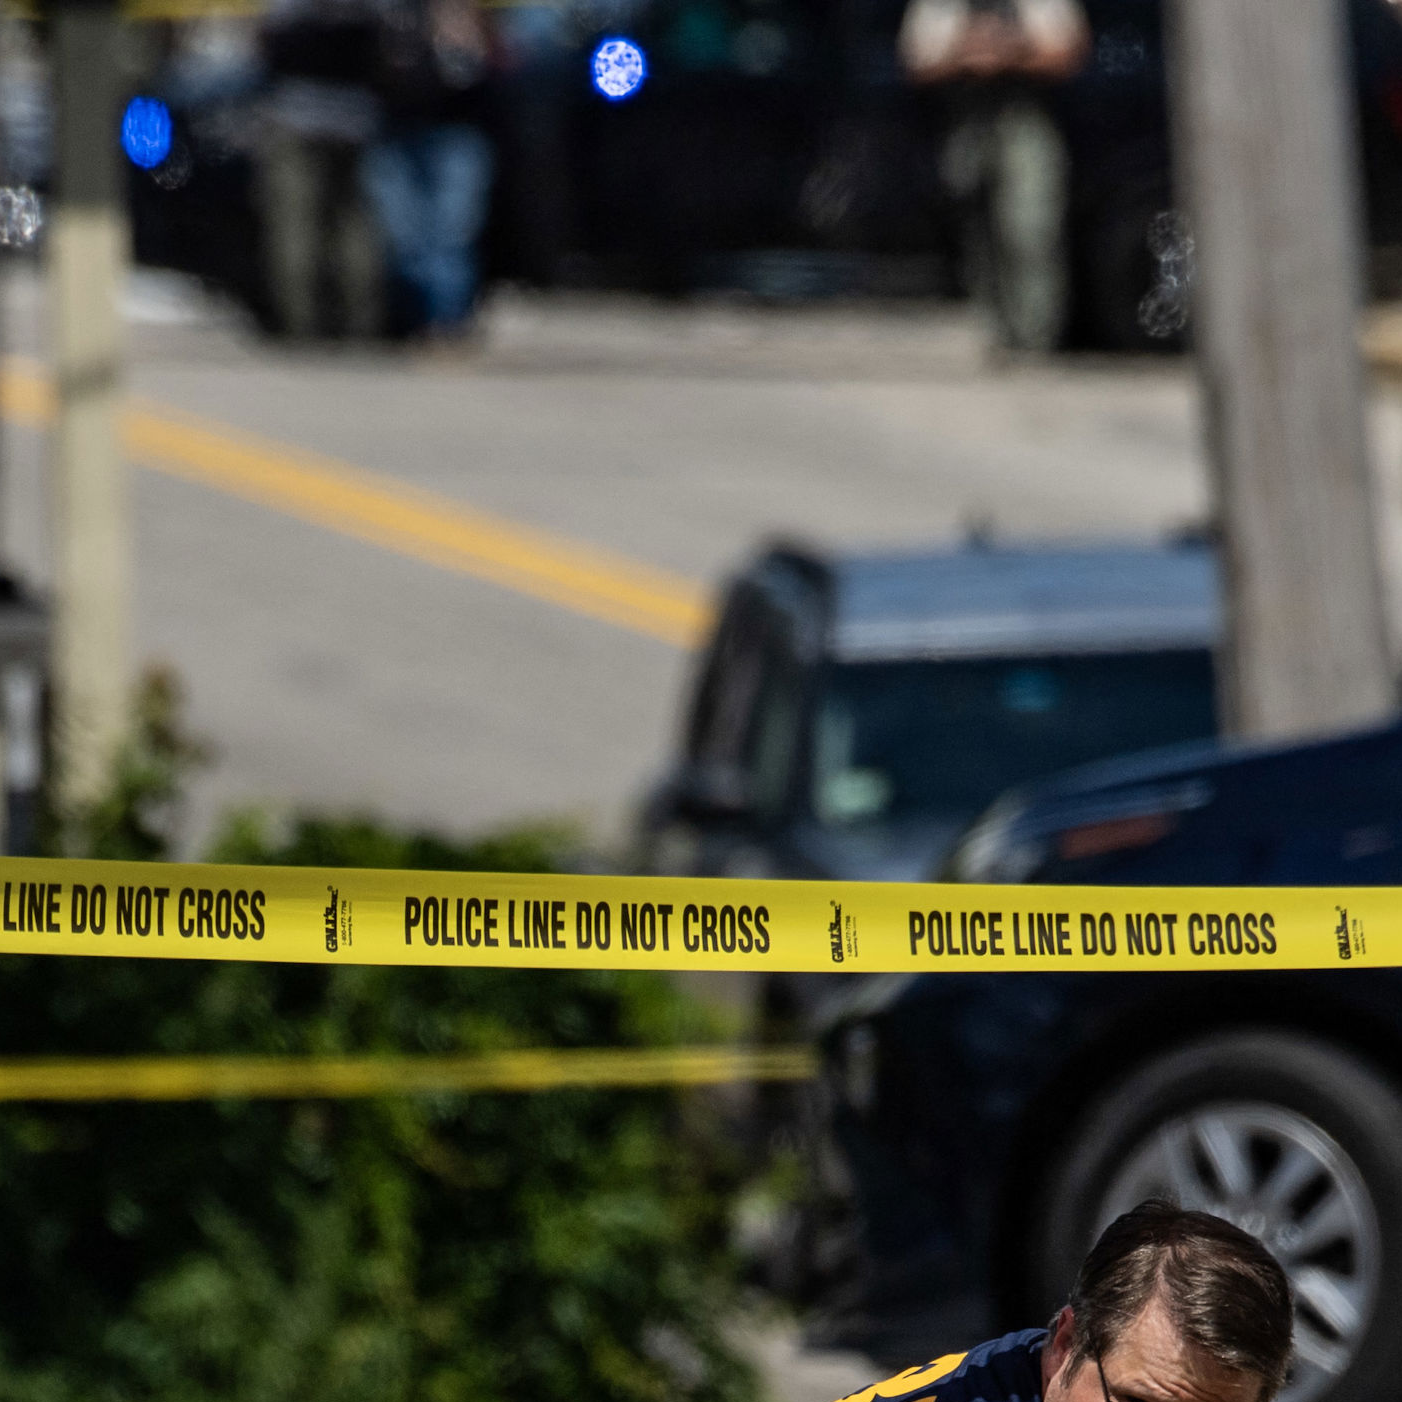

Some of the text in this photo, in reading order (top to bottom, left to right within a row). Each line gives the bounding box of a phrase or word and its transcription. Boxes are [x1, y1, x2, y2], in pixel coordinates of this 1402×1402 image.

[2, 881, 63, 934] LINE
[70, 883, 108, 936] DO
[115, 885, 171, 937] NOT
[177, 886, 266, 941] CROSS
[404, 895, 500, 948] POLICE
[507, 899, 567, 950] LINE
[575, 900, 611, 951] DO
[620, 902, 674, 952] NOT
[682, 903, 771, 954] CROSS
[908, 909, 1006, 957] POLICE
[1012, 911, 1073, 956] LINE
[1079, 911, 1117, 957] DO
[1124, 912, 1178, 957] NOT
[1187, 912, 1277, 956] CROSS
